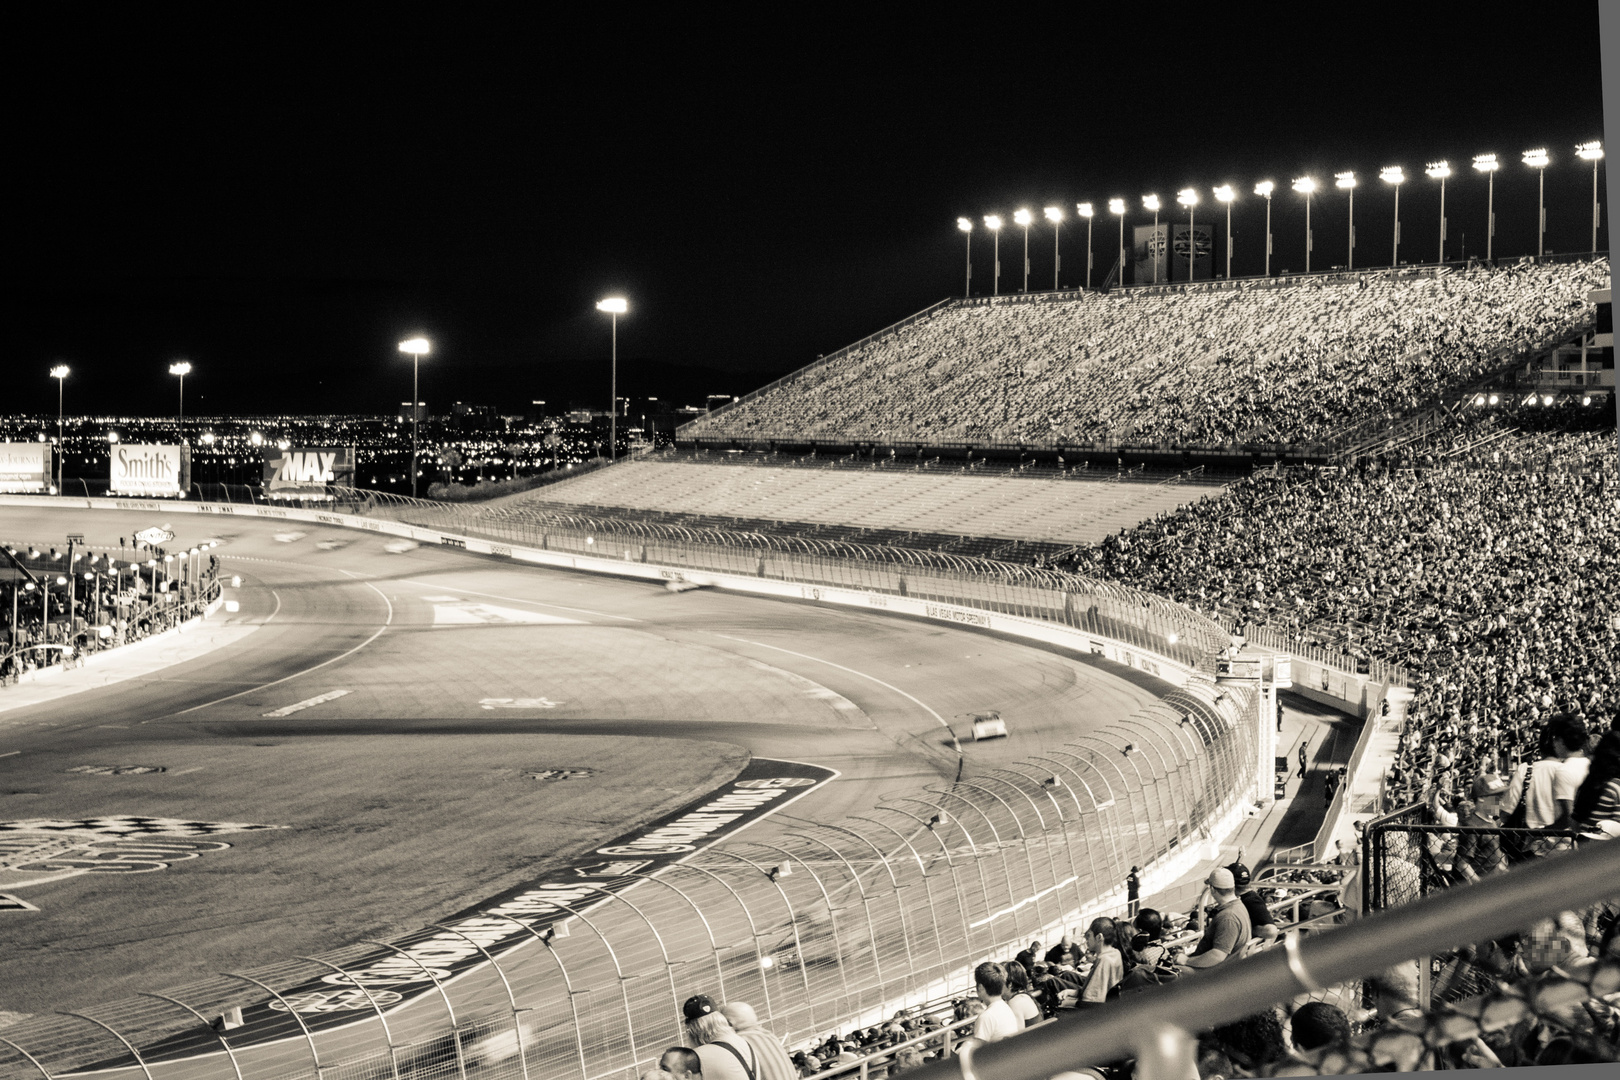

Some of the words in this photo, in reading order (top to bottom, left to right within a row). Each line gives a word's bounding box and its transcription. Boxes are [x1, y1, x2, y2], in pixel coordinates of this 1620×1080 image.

[118, 448, 172, 478] Smith's
[138, 532, 172, 540] SUNOCO
[629, 813, 744, 844] KOBALT
[696, 788, 787, 812] TOOLS
